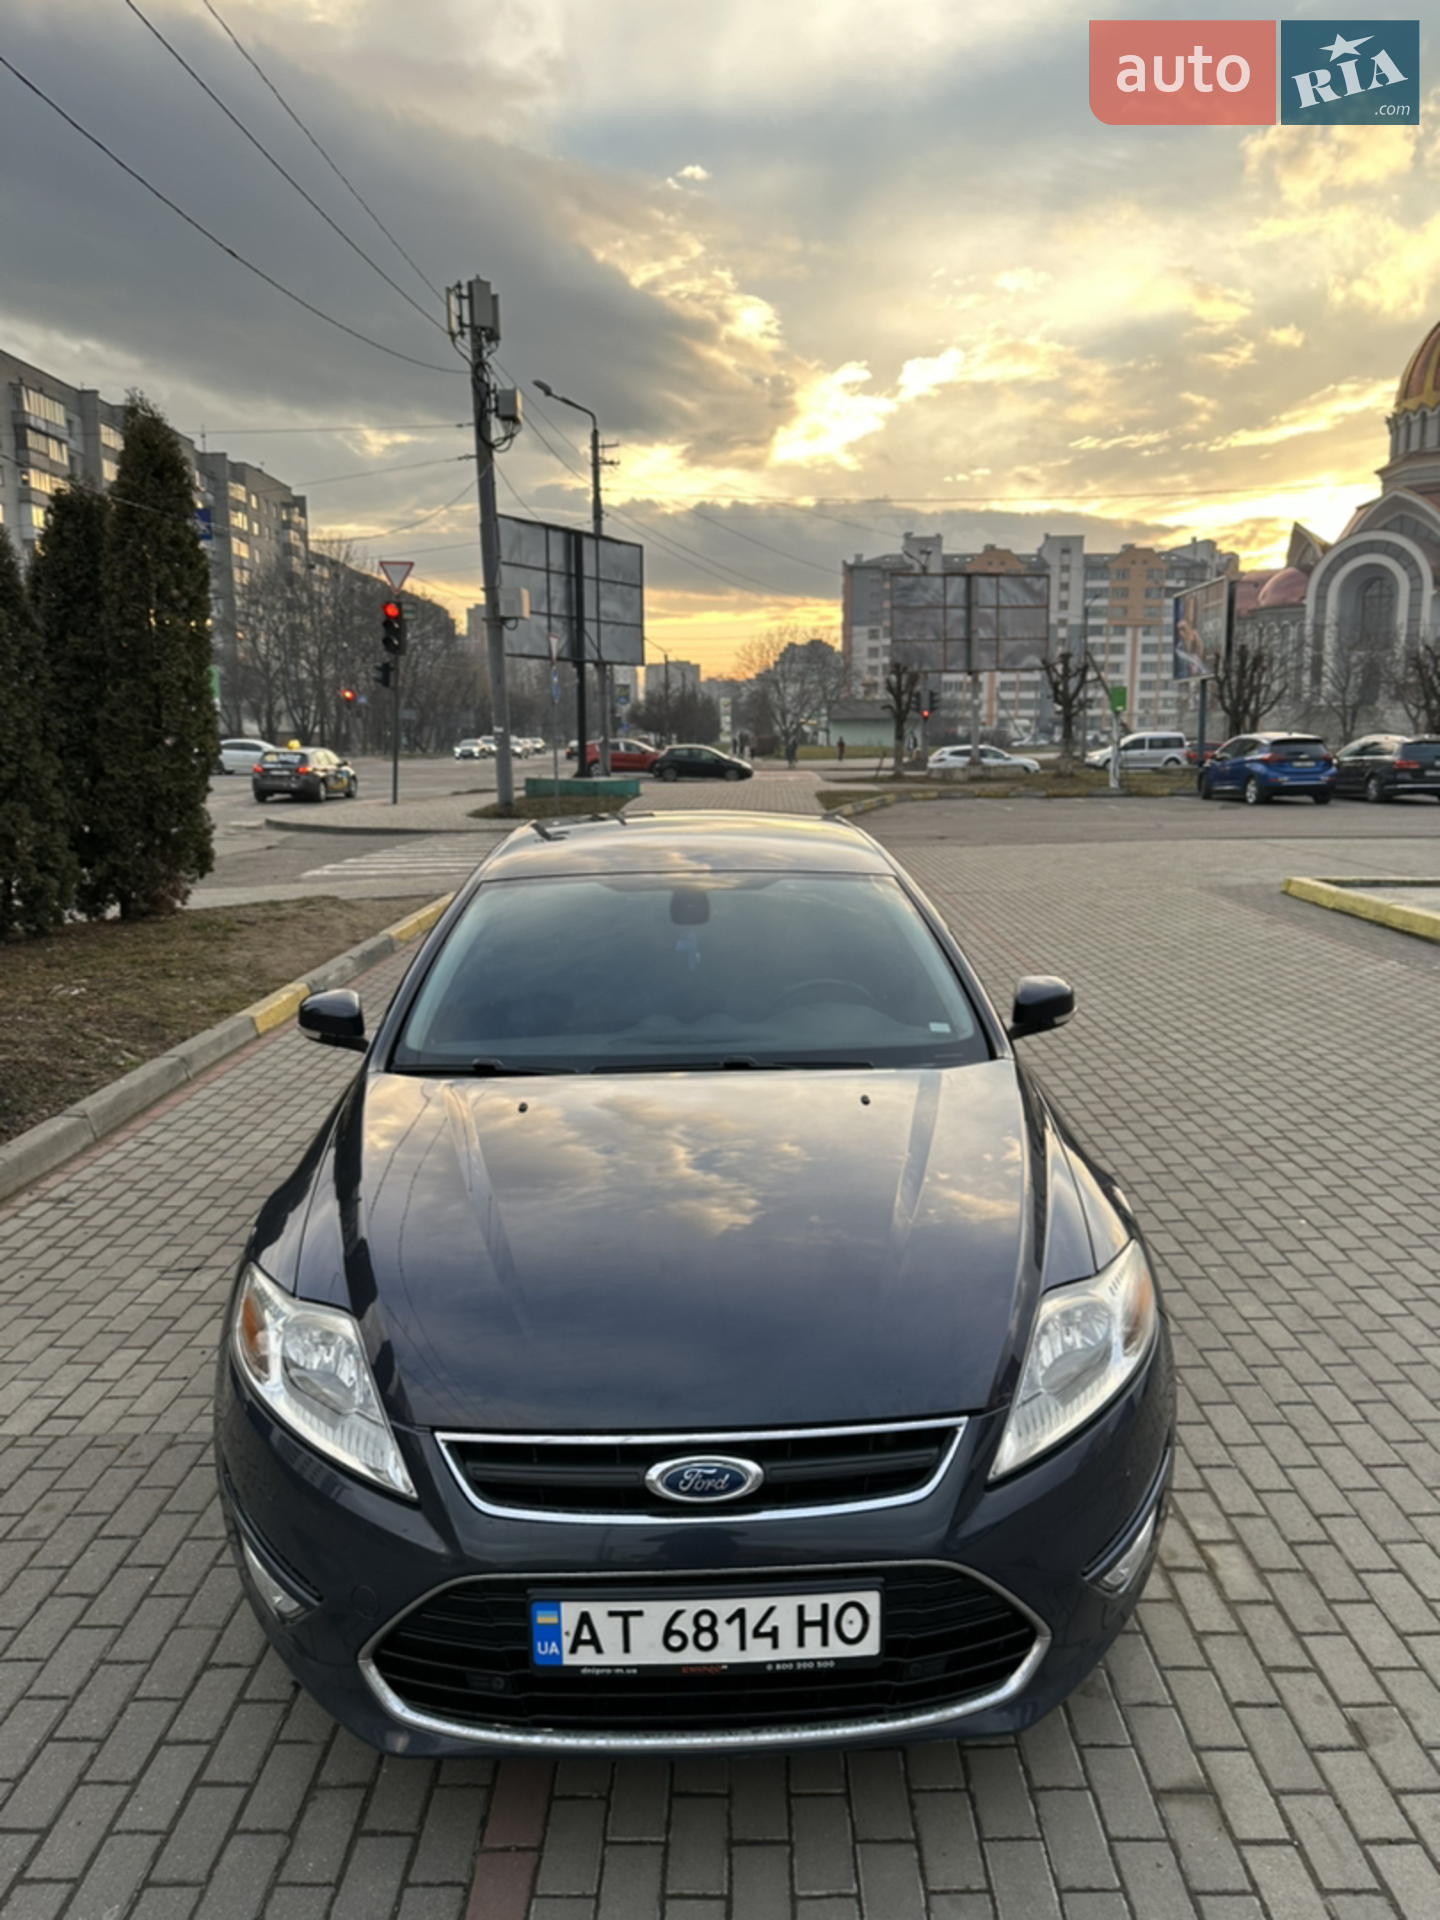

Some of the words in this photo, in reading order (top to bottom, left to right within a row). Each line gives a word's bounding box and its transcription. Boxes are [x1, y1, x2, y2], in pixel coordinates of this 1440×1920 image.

[678, 1467, 730, 1491] Ford
[569, 1610, 644, 1654] AT
[662, 1605, 779, 1653] 6814
[797, 1600, 870, 1648] HO
[536, 1641, 560, 1655] UA
